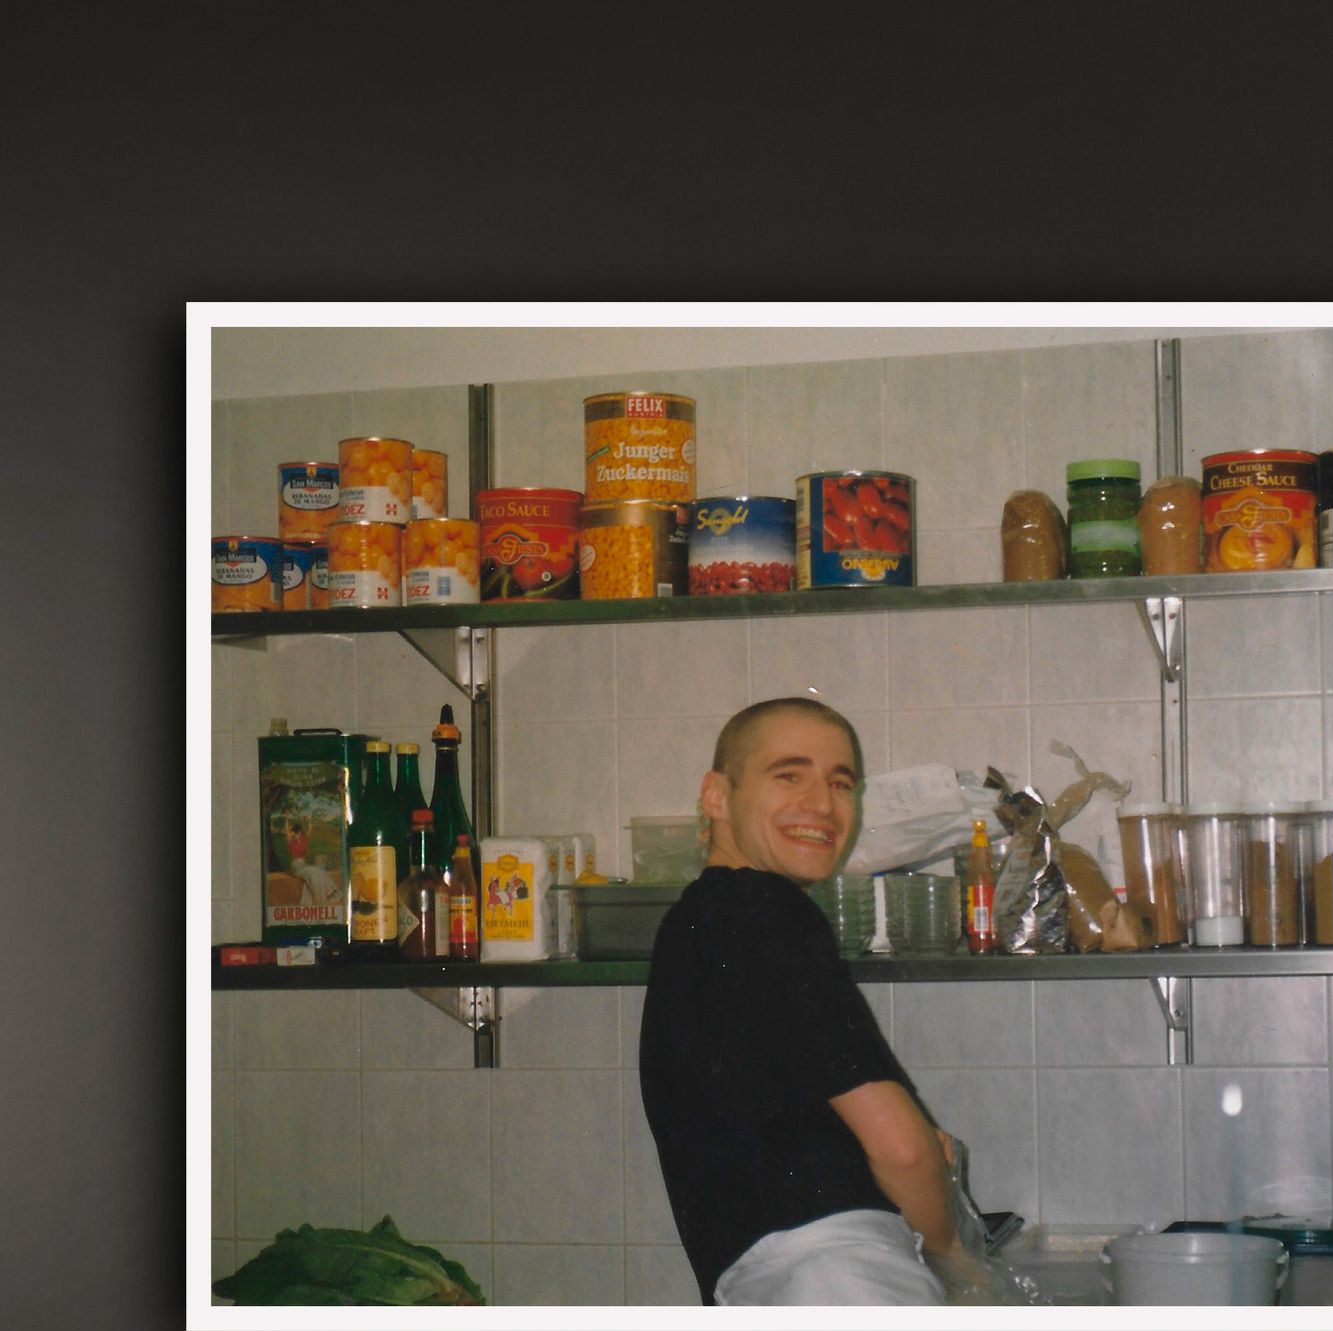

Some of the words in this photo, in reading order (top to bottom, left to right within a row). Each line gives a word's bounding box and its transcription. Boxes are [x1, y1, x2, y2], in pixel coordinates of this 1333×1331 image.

[627, 398, 663, 412] FELIX
[613, 442, 675, 464] Junger
[1228, 462, 1273, 474] CHEDDAR
[292, 479, 306, 489] SAN
[306, 478, 332, 489] MARCOS
[1210, 475, 1254, 490] CHEESE
[1256, 472, 1298, 487] SAUCE
[480, 504, 505, 519] TACO
[507, 501, 551, 517] SAUCE
[228, 553, 255, 563] MARCOS
[273, 906, 338, 921] CARBONELL
